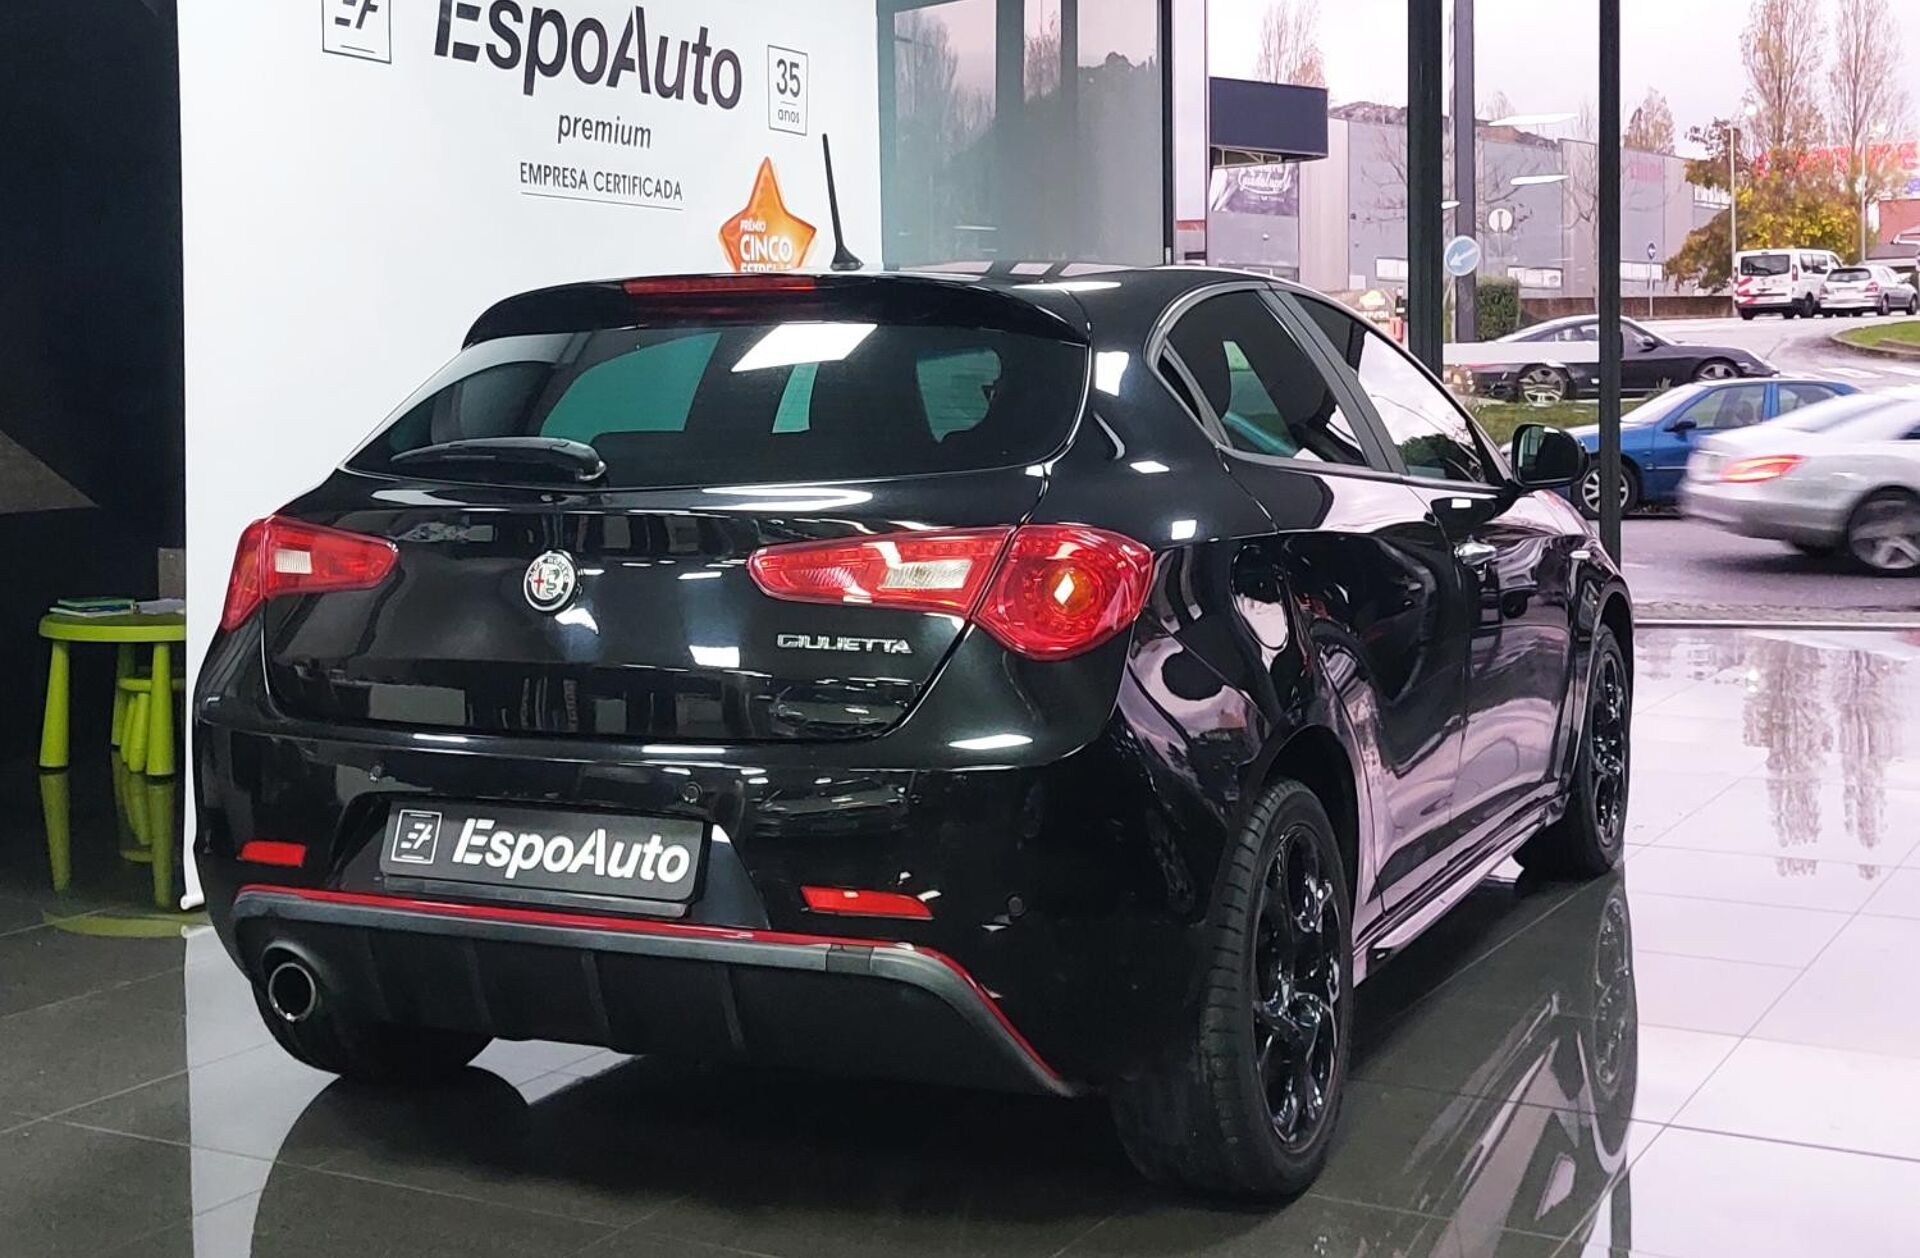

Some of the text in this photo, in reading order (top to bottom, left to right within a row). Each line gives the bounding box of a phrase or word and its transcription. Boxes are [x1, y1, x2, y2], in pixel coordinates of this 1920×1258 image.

[434, 0, 742, 110] EspoAuto
[776, 58, 801, 98] 35
[557, 114, 651, 149] premium
[778, 108, 800, 124] anos
[520, 162, 683, 201] EMPRESA CERTIFICADA
[740, 233, 793, 263] CINCO
[777, 634, 913, 654] GIULIETTA
[452, 818, 691, 884] EspoAuto
